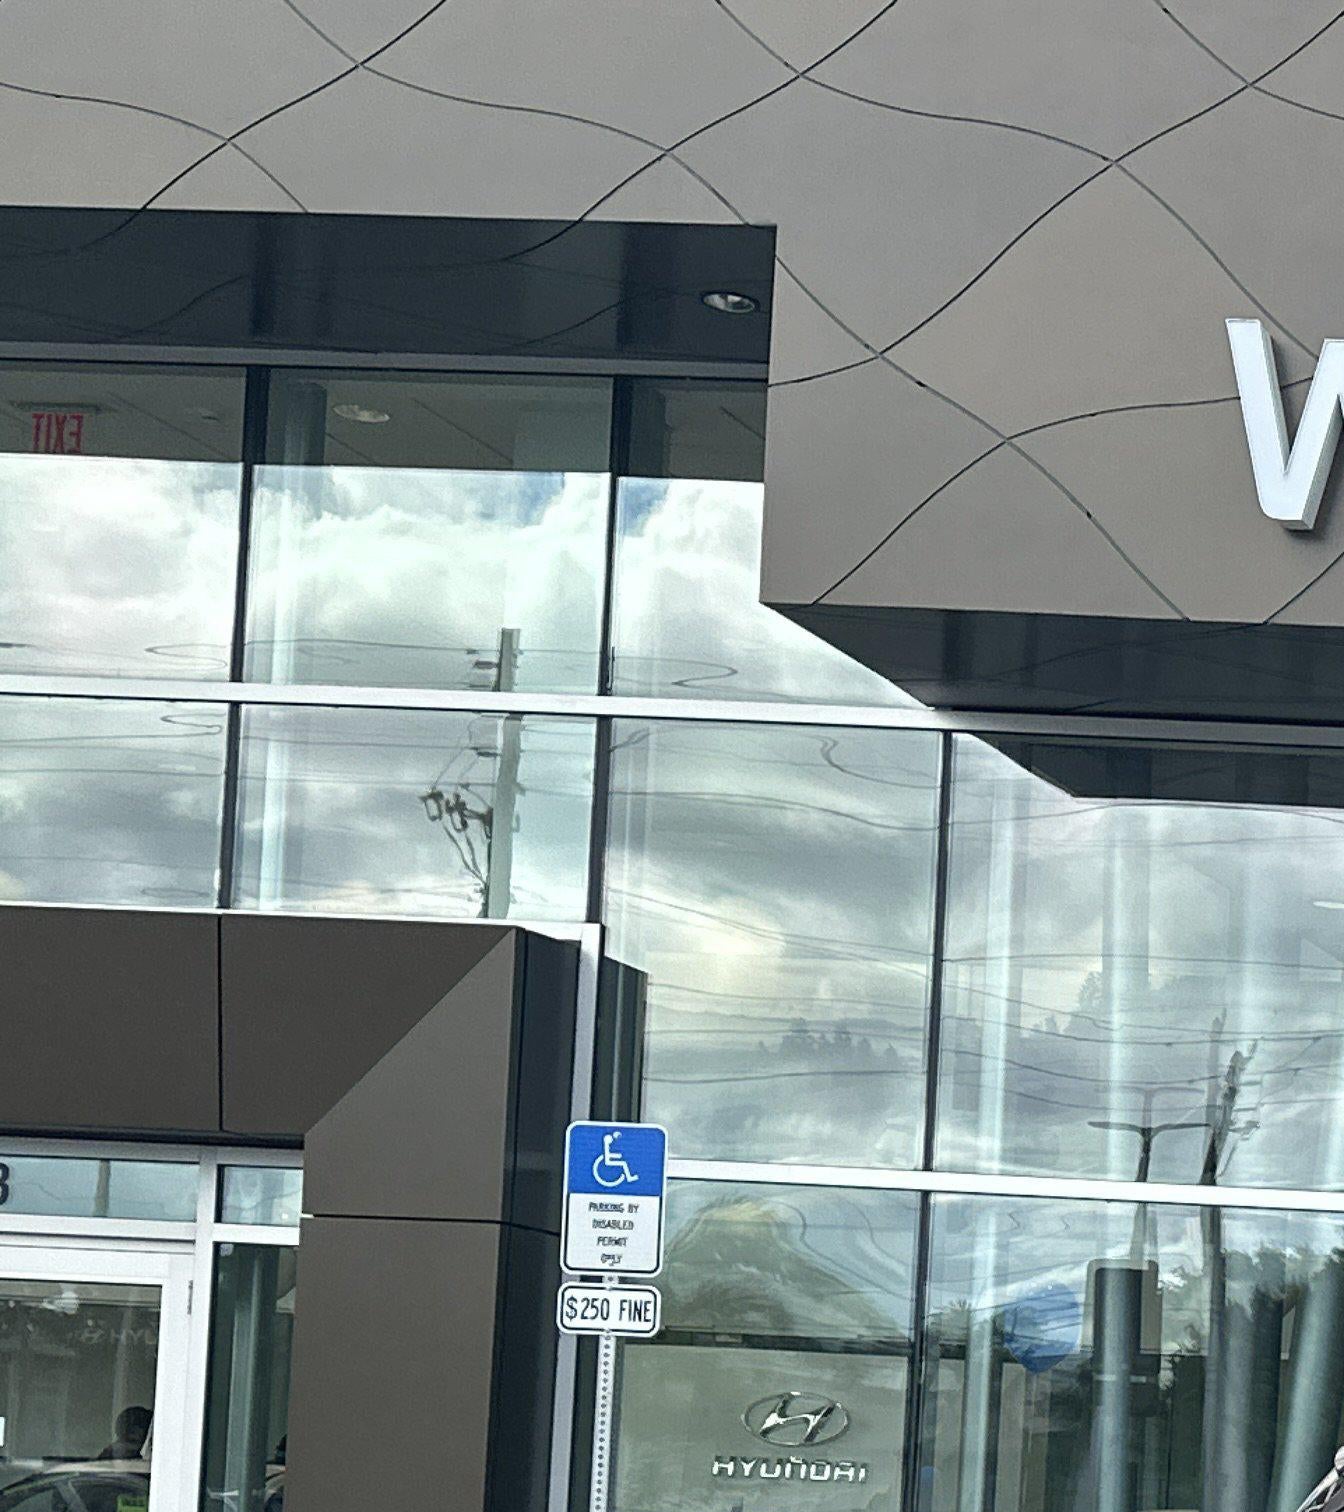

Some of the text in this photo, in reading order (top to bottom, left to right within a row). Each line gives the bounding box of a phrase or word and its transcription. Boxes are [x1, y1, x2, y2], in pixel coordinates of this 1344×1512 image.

[588, 1202, 640, 1213] PARKING BY
[592, 1219, 634, 1231] DISABLED
[596, 1236, 628, 1247] PERMIT
[565, 1296, 652, 1323] $250 FINE
[712, 1455, 868, 1482] HYUNDAI
